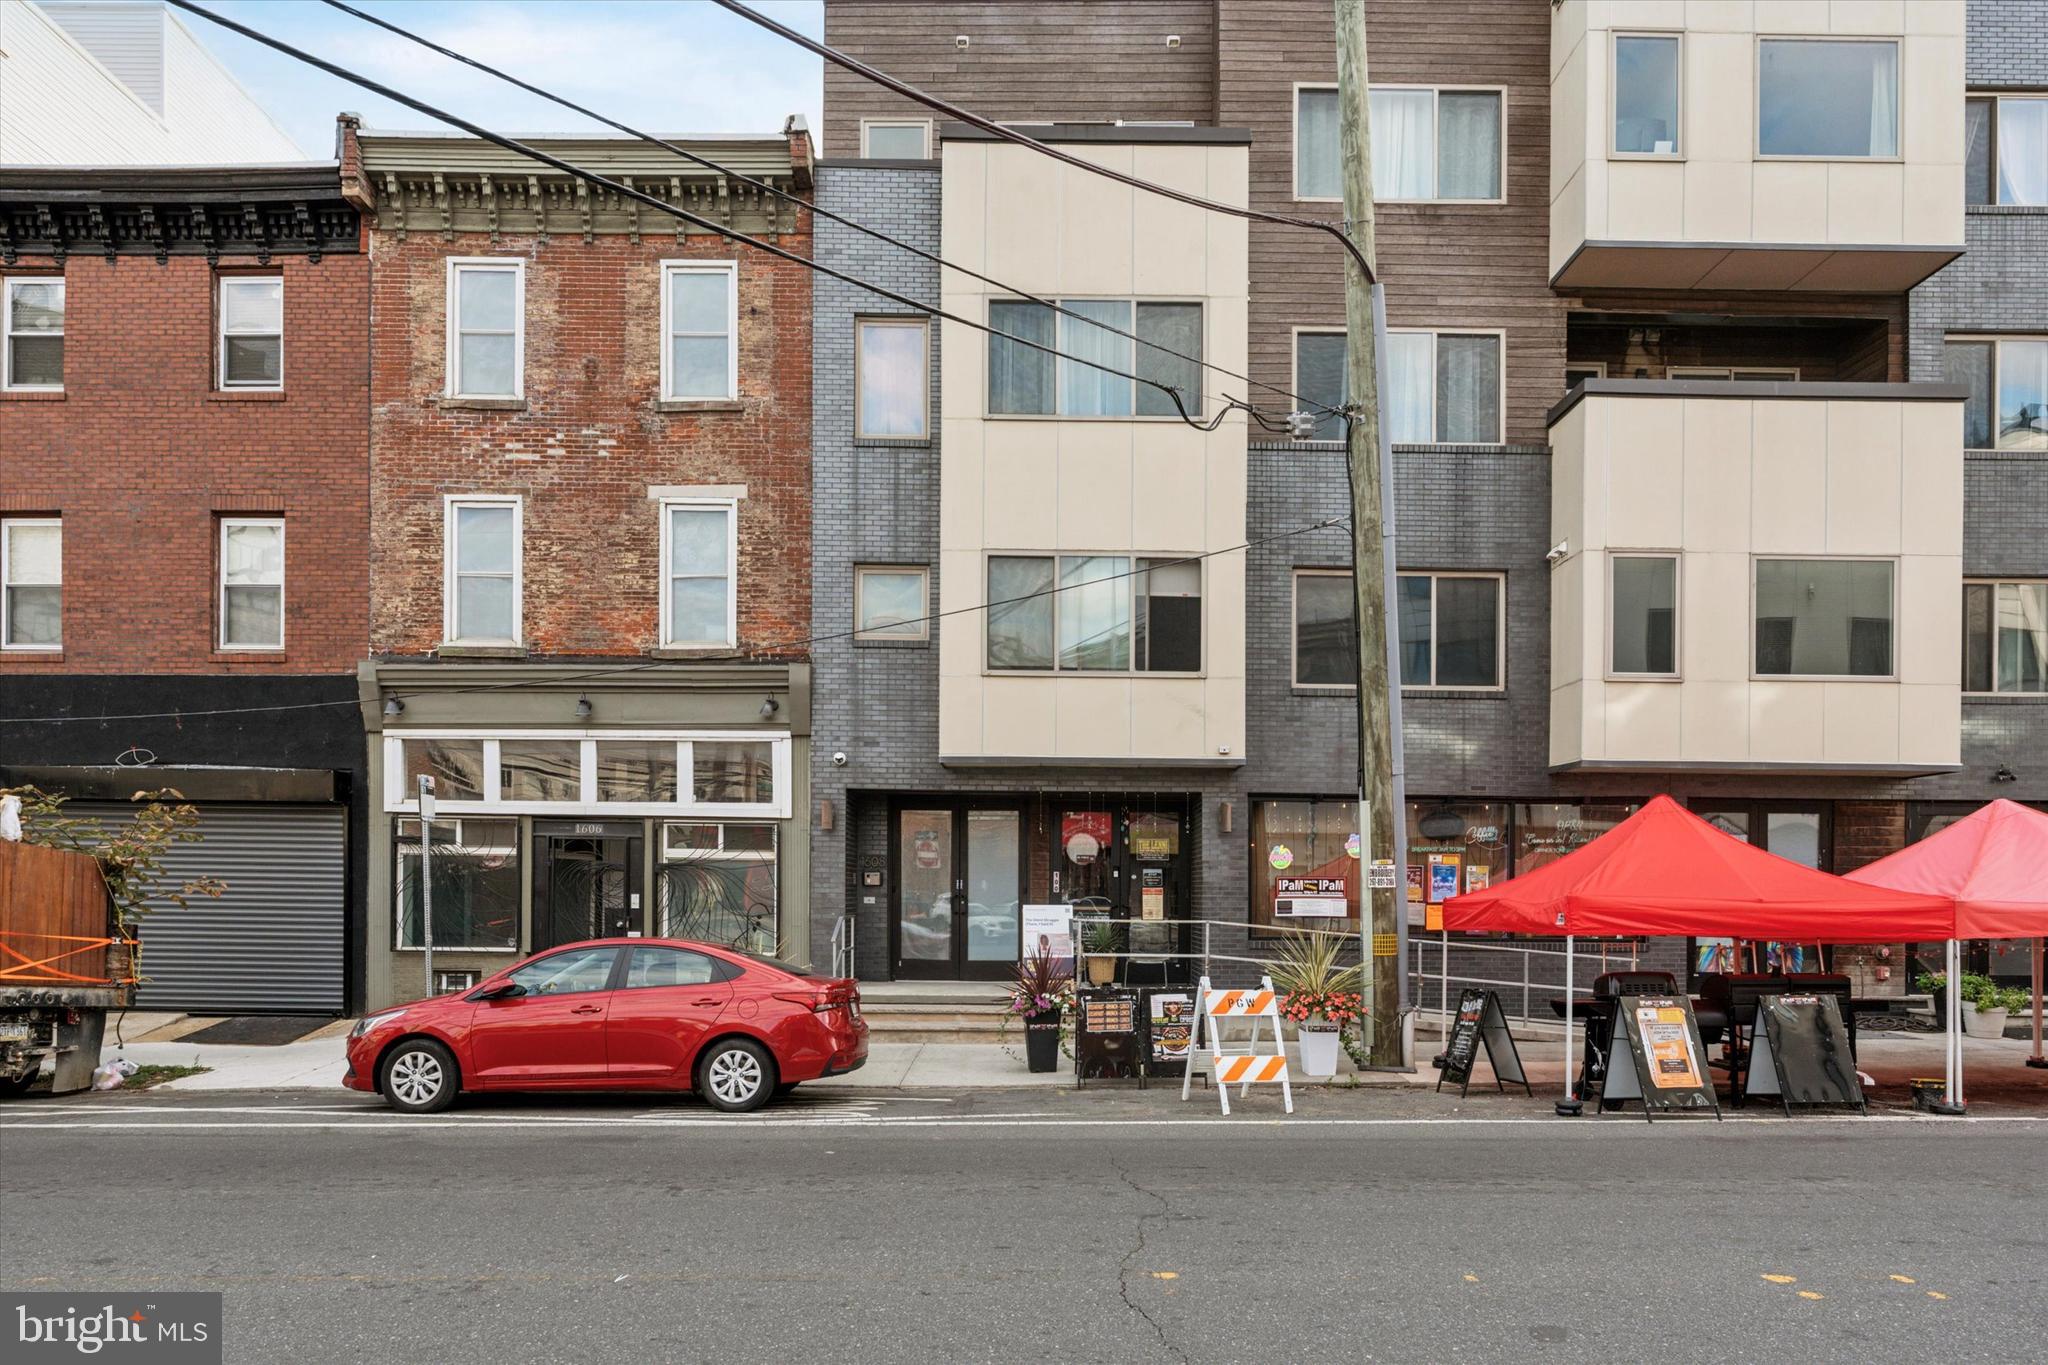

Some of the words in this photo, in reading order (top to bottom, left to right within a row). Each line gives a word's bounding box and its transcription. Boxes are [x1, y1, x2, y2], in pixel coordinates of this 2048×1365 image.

[575, 823, 603, 834] 1606
[1465, 826, 1498, 845] Coffee
[1279, 880, 1304, 891] IPaM
[1318, 880, 1344, 891] IPaM
